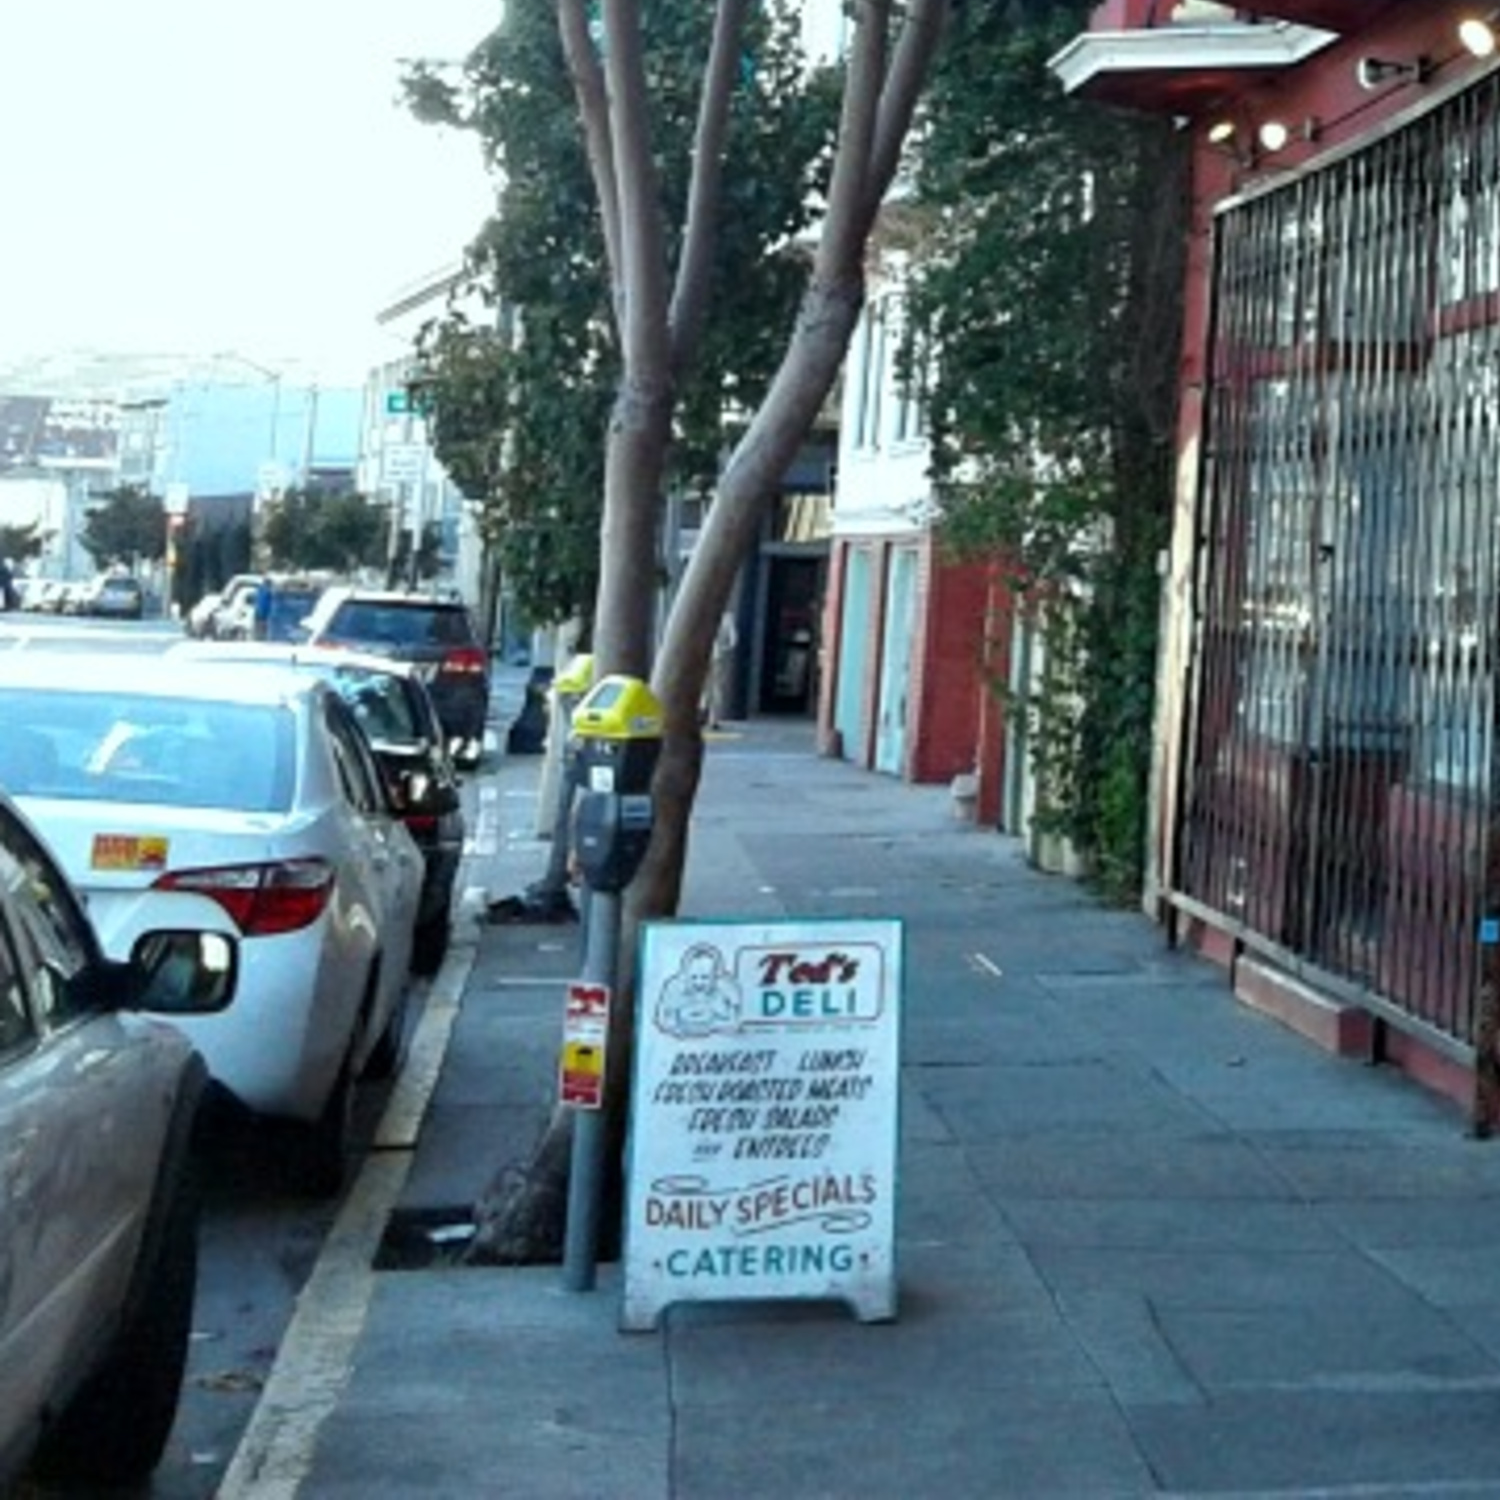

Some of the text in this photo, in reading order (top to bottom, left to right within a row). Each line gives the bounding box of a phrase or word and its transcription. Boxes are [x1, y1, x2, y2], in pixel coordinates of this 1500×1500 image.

[761, 989, 857, 1017] DELI
[645, 1172, 877, 1230] DAILY SPECIALS
[666, 1244, 853, 1277] CATERING
